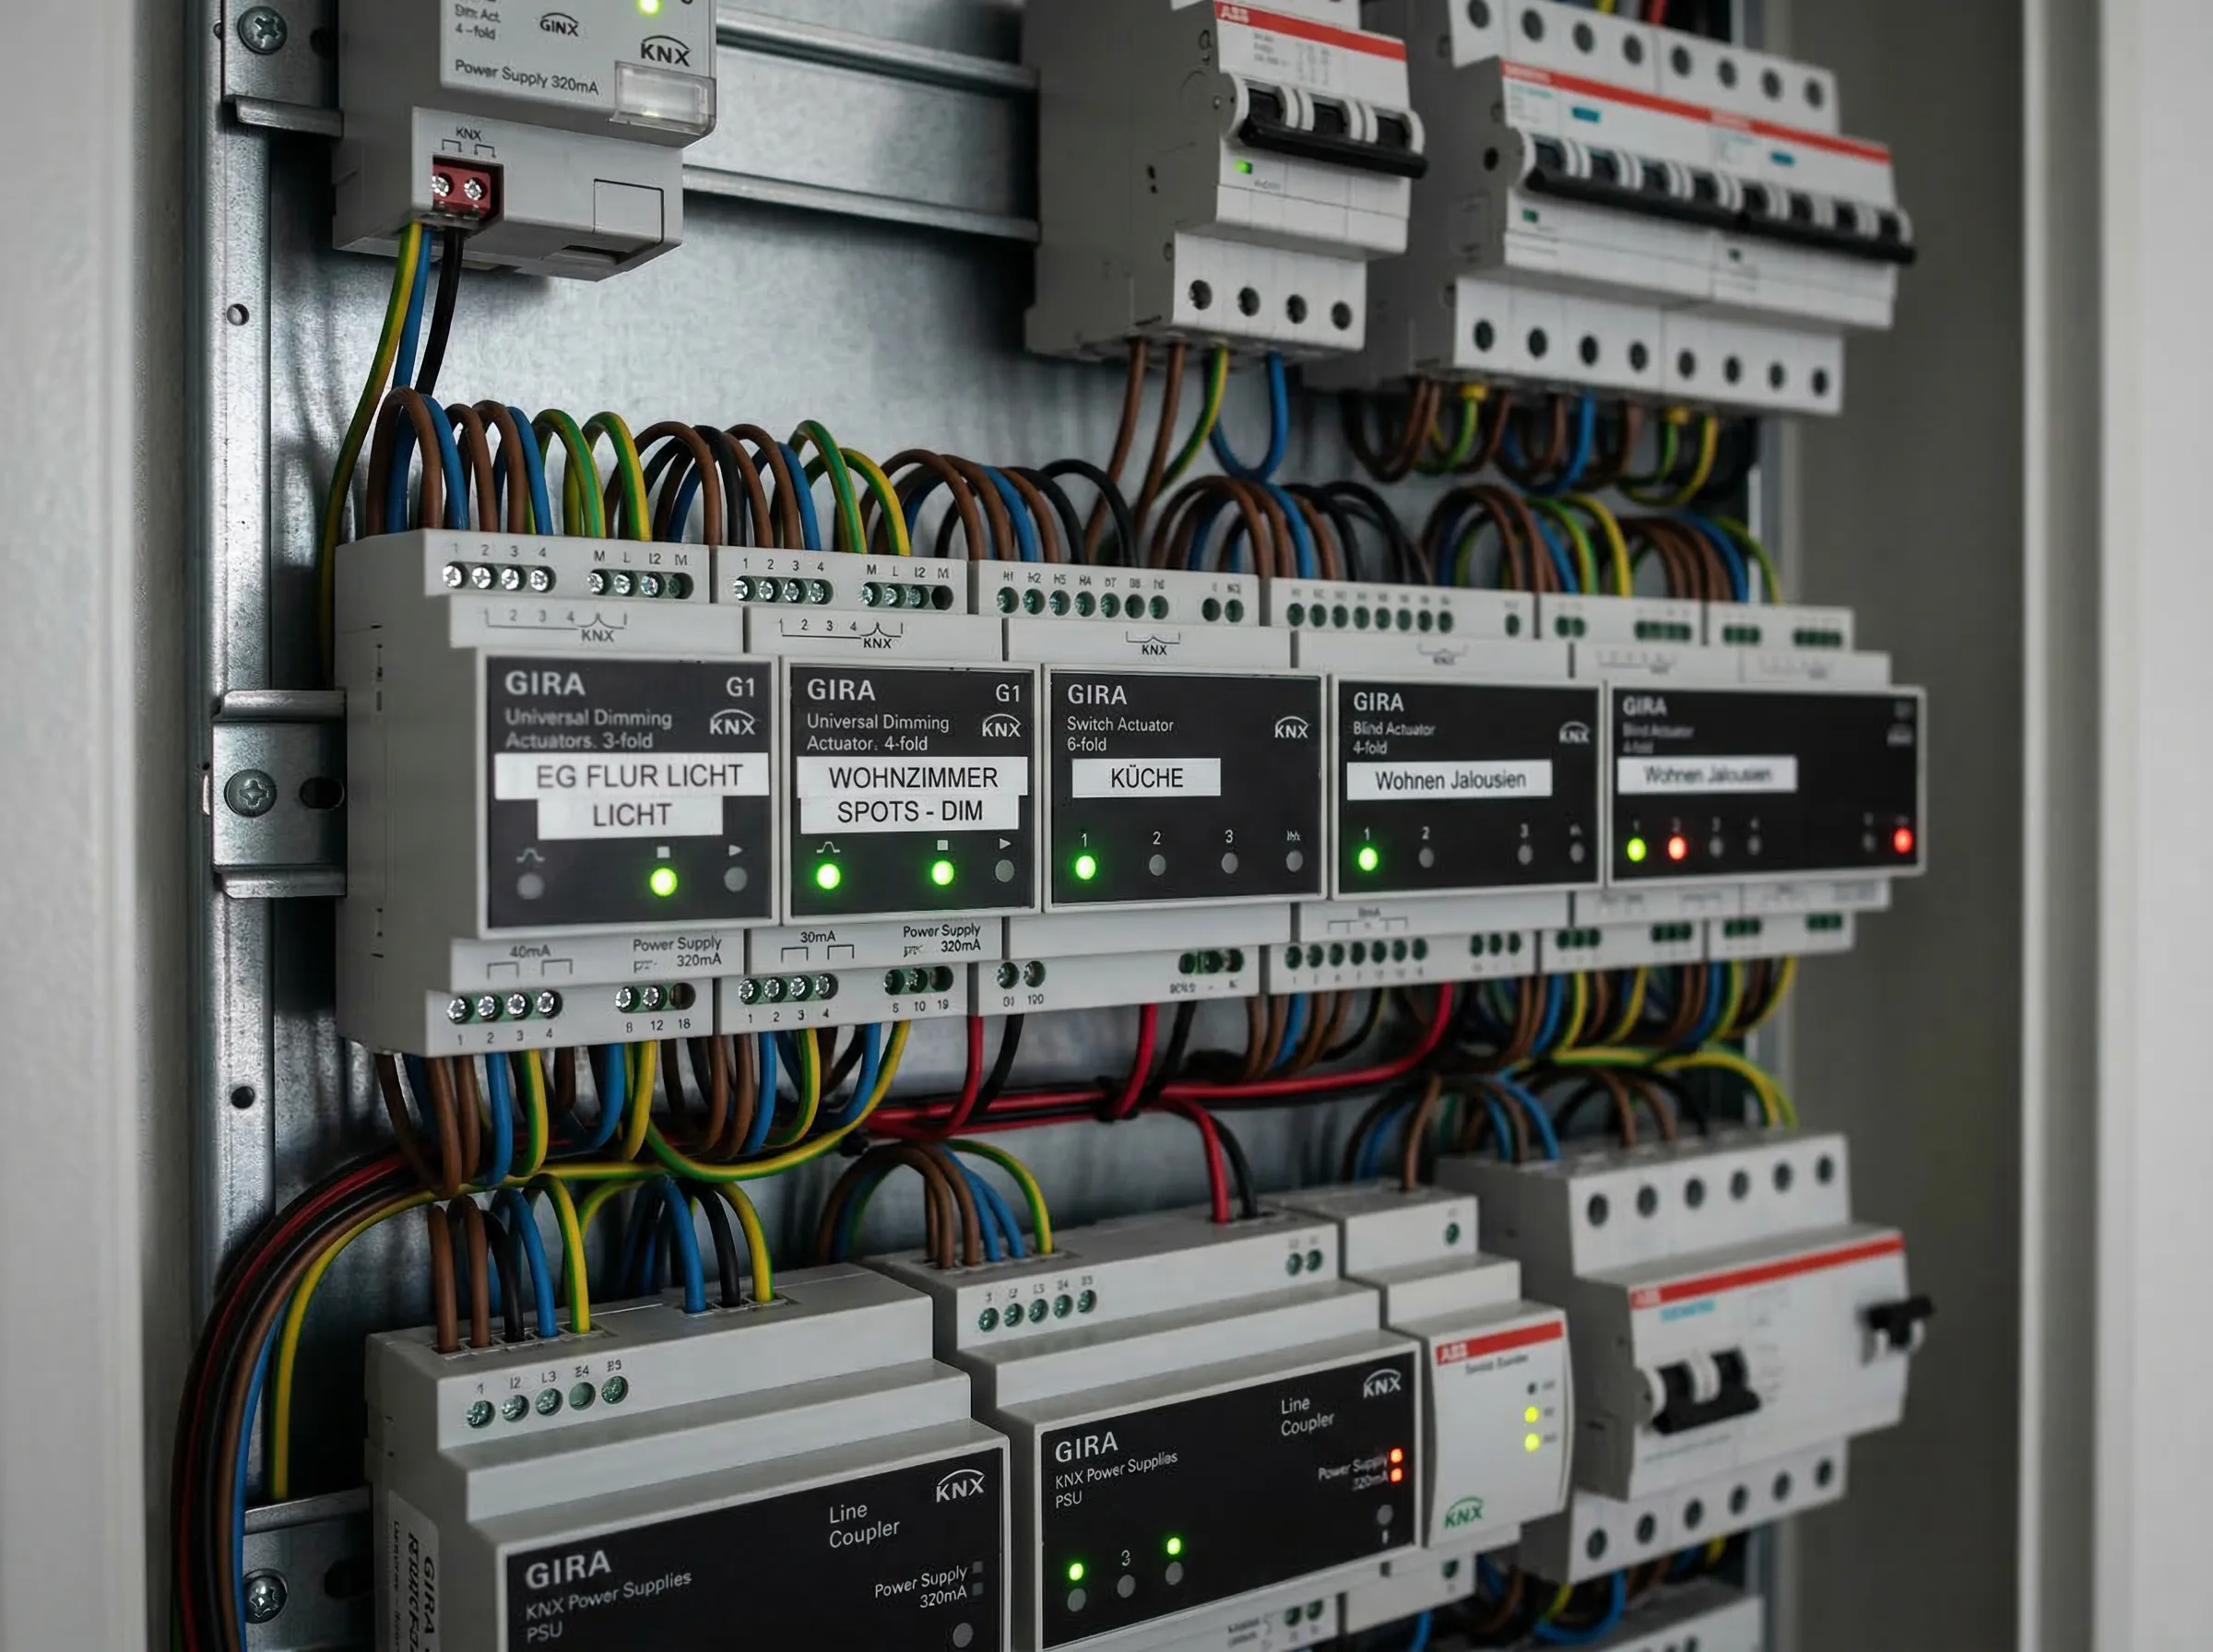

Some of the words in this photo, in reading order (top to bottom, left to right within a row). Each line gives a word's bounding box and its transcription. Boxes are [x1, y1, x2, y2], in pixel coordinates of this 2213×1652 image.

[540, 19, 579, 37] GINX
[641, 42, 691, 67] KNX
[456, 59, 499, 77] Power
[502, 66, 548, 88] Supply
[551, 76, 598, 95] 320mA
[456, 126, 482, 141] KNX
[481, 544, 490, 556] 2
[510, 545, 518, 557] 3
[538, 546, 547, 558] 4
[594, 549, 606, 562] M
[623, 551, 631, 563] L
[675, 554, 688, 566] M
[743, 558, 748, 569] 1
[767, 559, 774, 570] 2
[793, 560, 799, 571] 3
[817, 561, 824, 572] 4
[867, 564, 877, 574] M
[893, 566, 898, 576] L
[938, 568, 949, 578] M
[801, 620, 808, 631] 2
[827, 620, 833, 631] 3
[850, 621, 857, 631] 4
[582, 629, 614, 643] KNX
[863, 638, 892, 649] KNX
[1142, 645, 1167, 655] KNX
[505, 671, 586, 696] GIRA
[727, 677, 755, 697] G1
[807, 678, 876, 701] GIRA
[996, 684, 1020, 702] G1
[1068, 684, 1128, 705] GIRA
[1354, 692, 1404, 712] GIRA
[506, 709, 588, 726] Universal
[595, 709, 672, 729] Dimming
[710, 719, 755, 735] KNX
[807, 714, 878, 728] Universal
[883, 714, 949, 733] Dimming
[1067, 716, 1114, 732] Switch
[1118, 717, 1174, 732] Actuator
[982, 723, 1021, 737] KNX
[1275, 726, 1308, 738] KNX
[1386, 722, 1436, 737] Actuator
[602, 732, 653, 749] 3-fold
[884, 737, 928, 750] 4-fold
[1067, 737, 1106, 751] 6-fold
[537, 765, 576, 788] EG
[587, 764, 658, 787] FLUR
[668, 764, 743, 787] LICHT
[829, 767, 999, 788] WOHNZIMMER
[1111, 764, 1183, 788] KÜCHE
[1376, 771, 1445, 790] Wohnen
[1450, 770, 1527, 789] Jalousien
[593, 804, 672, 826] LICHT
[837, 800, 919, 822] SPOTS
[941, 800, 983, 821] DIM
[1082, 833, 1087, 847] 1
[1153, 832, 1161, 844] 2
[1225, 830, 1234, 844] 3
[1364, 827, 1369, 841] 1
[1422, 826, 1429, 840] 2
[800, 930, 836, 943] 30mA
[903, 925, 940, 938] Power
[941, 924, 980, 939] Supply
[510, 945, 550, 959] 40mA
[633, 938, 674, 953] Power
[678, 936, 722, 952] Supply
[941, 939, 981, 952] 320mA
[677, 953, 722, 967] 320mA
[774, 1012, 780, 1022] 2
[798, 1010, 804, 1021] 3
[822, 1009, 829, 1018] 4
[915, 1001, 926, 1011] 10
[488, 1032, 494, 1044] 2
[516, 1030, 524, 1041] 3
[546, 1027, 552, 1038] 4
[651, 1020, 664, 1031] 12
[678, 1019, 691, 1030] 18
[1363, 1377, 1401, 1398] KNX
[1282, 1397, 1310, 1414] Line
[1282, 1413, 1335, 1435] Coupler
[1055, 1432, 1118, 1463] GIRA
[1056, 1470, 1083, 1490] KNX
[1087, 1463, 1125, 1482] Power
[936, 1476, 985, 1503] KNX
[1056, 1491, 1083, 1509] PSU
[830, 1504, 868, 1524] Line
[1445, 1505, 1483, 1529] KNX
[830, 1521, 900, 1548] Coupler
[1121, 1550, 1130, 1566] 3
[526, 1550, 611, 1590] GIRA
[875, 1578, 917, 1598] Power
[921, 1565, 967, 1587] Supply
[526, 1598, 564, 1621] KNX
[569, 1588, 619, 1611] Power
[623, 1572, 692, 1598] Supplies
[920, 1586, 967, 1608] 320mA
[527, 1622, 562, 1644] PSU
